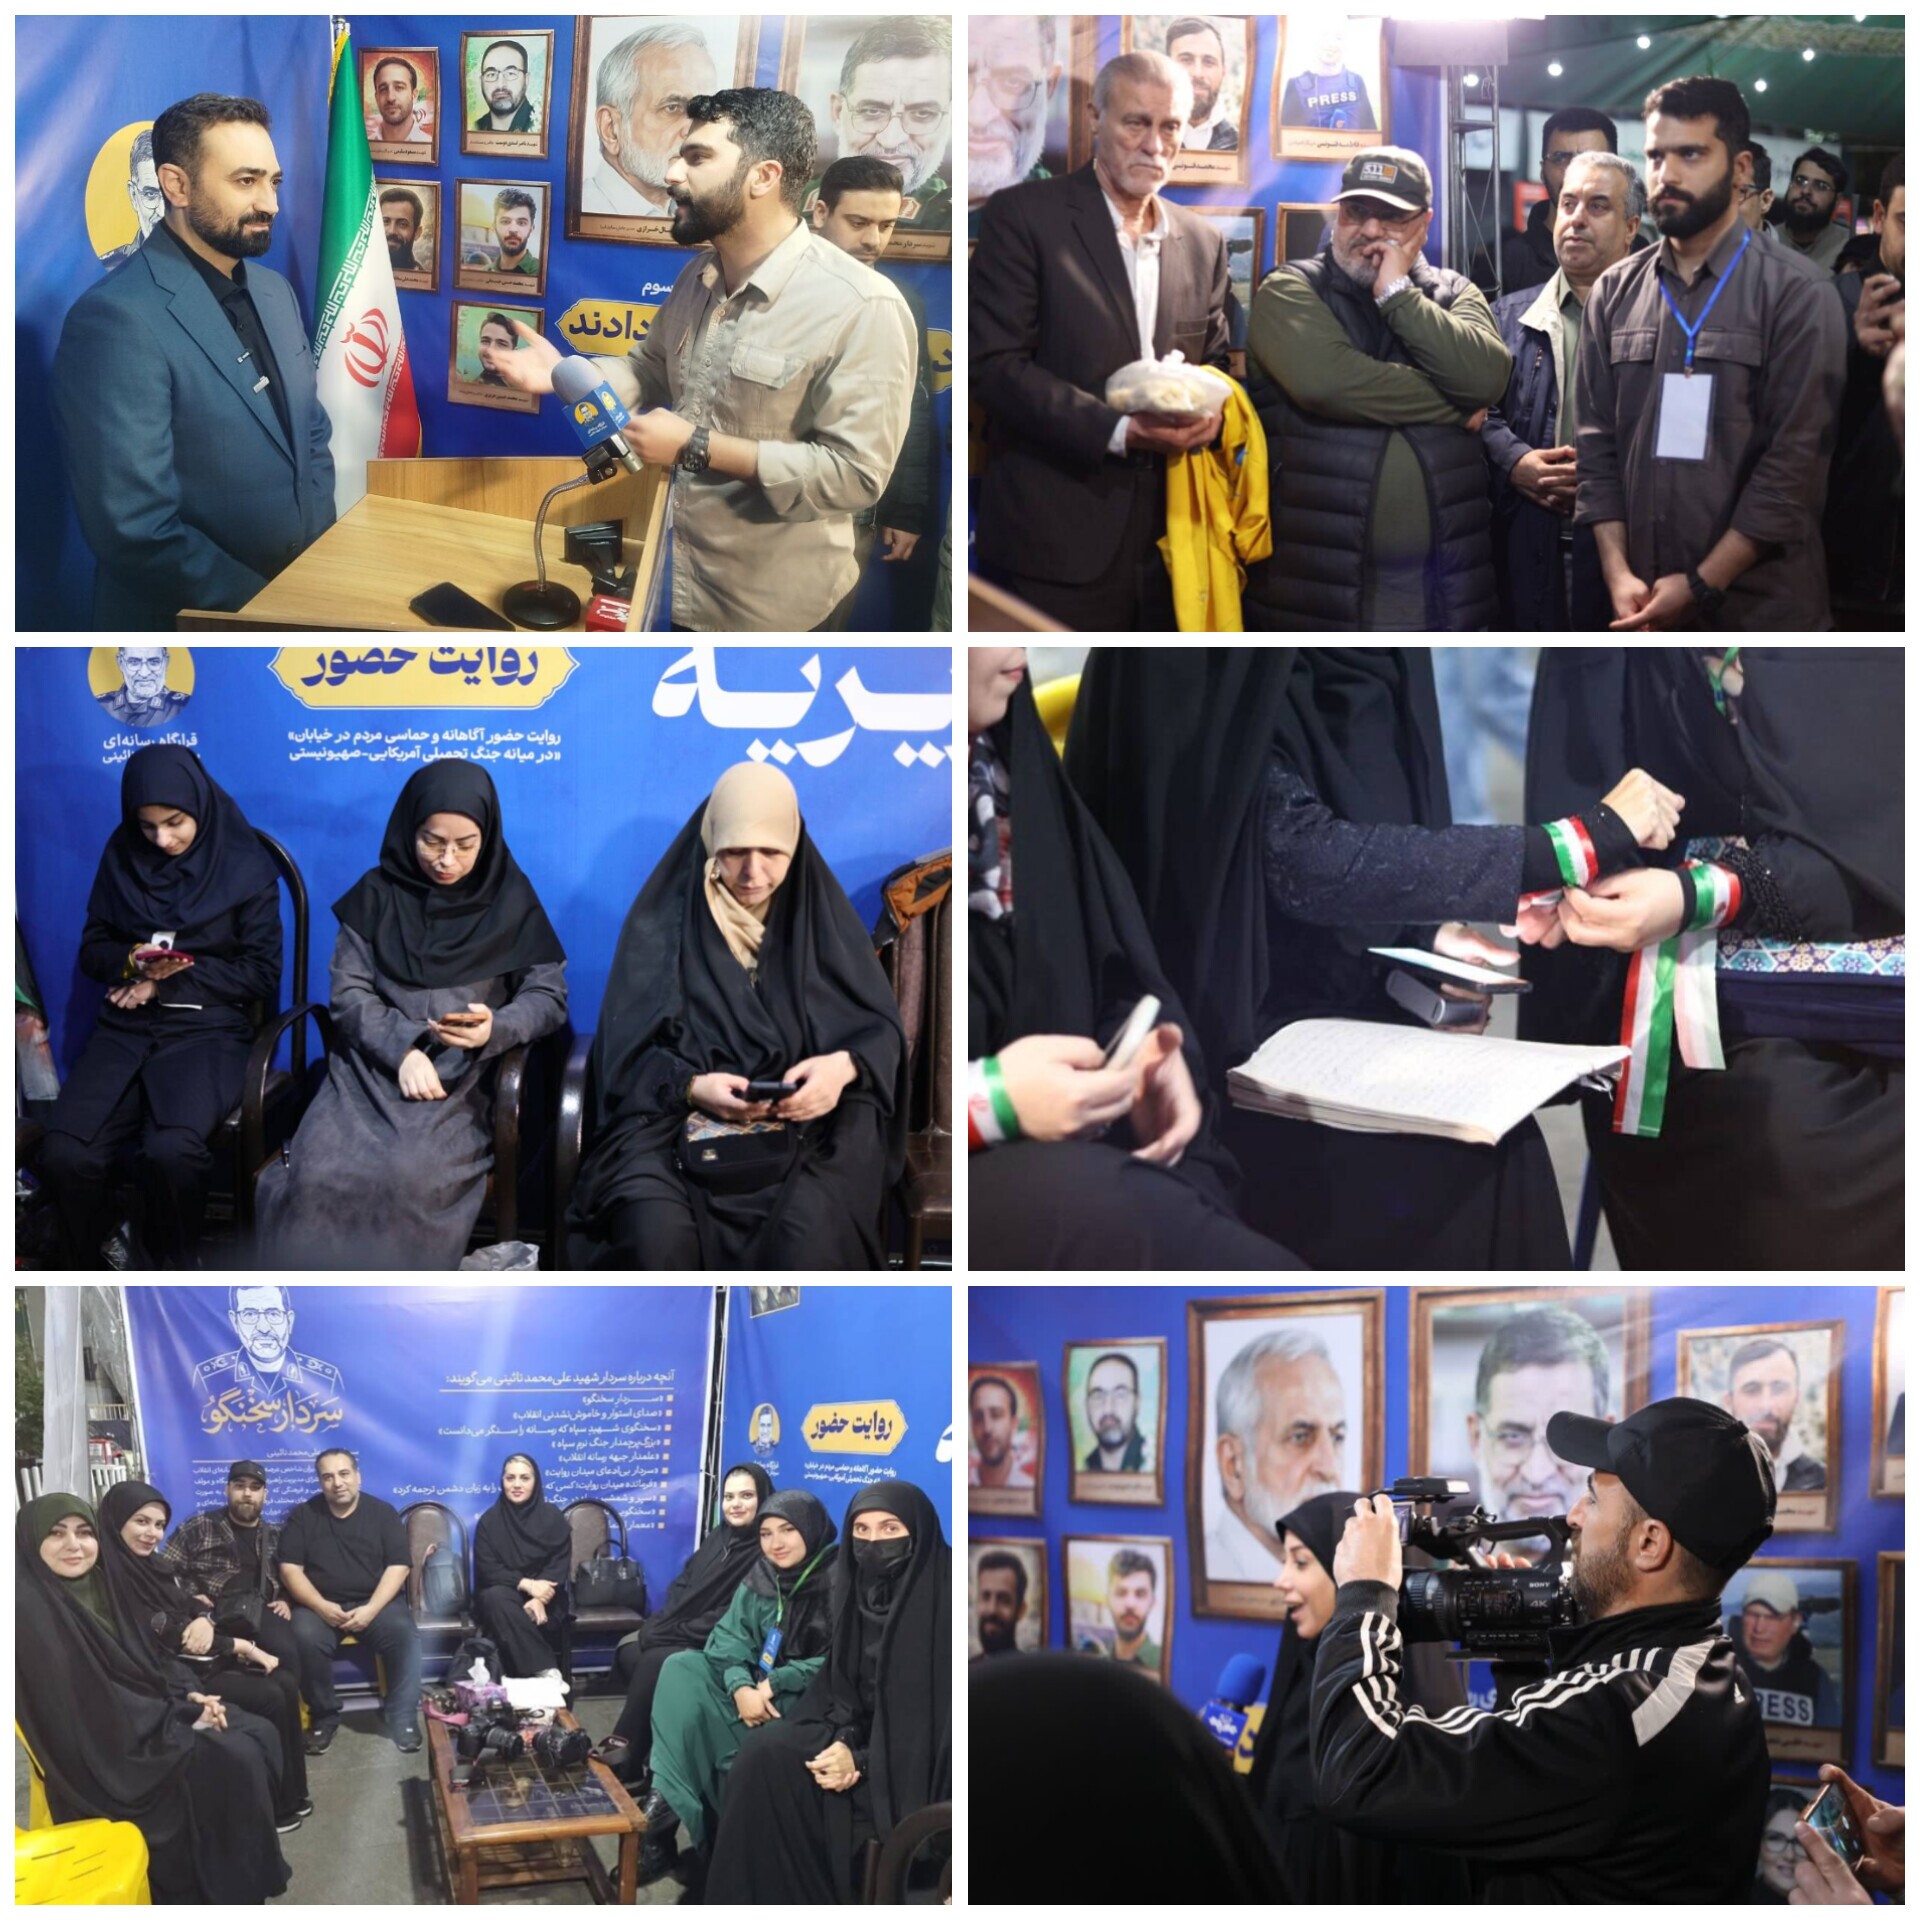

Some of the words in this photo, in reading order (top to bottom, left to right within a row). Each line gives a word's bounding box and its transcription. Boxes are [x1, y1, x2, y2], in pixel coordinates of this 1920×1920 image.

[1307, 91, 1357, 108] PRESS
[428, 647, 539, 686] روایت
[337, 731, 351, 744] در
[353, 731, 383, 745] مردم
[385, 728, 428, 744] حماسی
[432, 733, 440, 745] و
[442, 727, 485, 741] آگاهانه
[486, 728, 525, 745] حضور
[527, 728, 561, 745] روایت
[102, 749, 134, 764] ائینی
[423, 746, 469, 761] تحمیلی
[470, 745, 502, 762] جنگ
[503, 746, 534, 761] میانه
[493, 1371, 523, 1386] نائینی
[572, 1371, 599, 1385] شهید
[598, 1370, 627, 1385] سردار
[628, 1370, 652, 1385] درباره
[653, 1369, 675, 1386] آنچه
[600, 1411, 607, 1420] و
[810, 1412, 849, 1440] حضور
[852, 1410, 893, 1441] روایت
[1528, 1599, 1549, 1608] 4K
[1755, 1691, 1810, 1722] RESS
